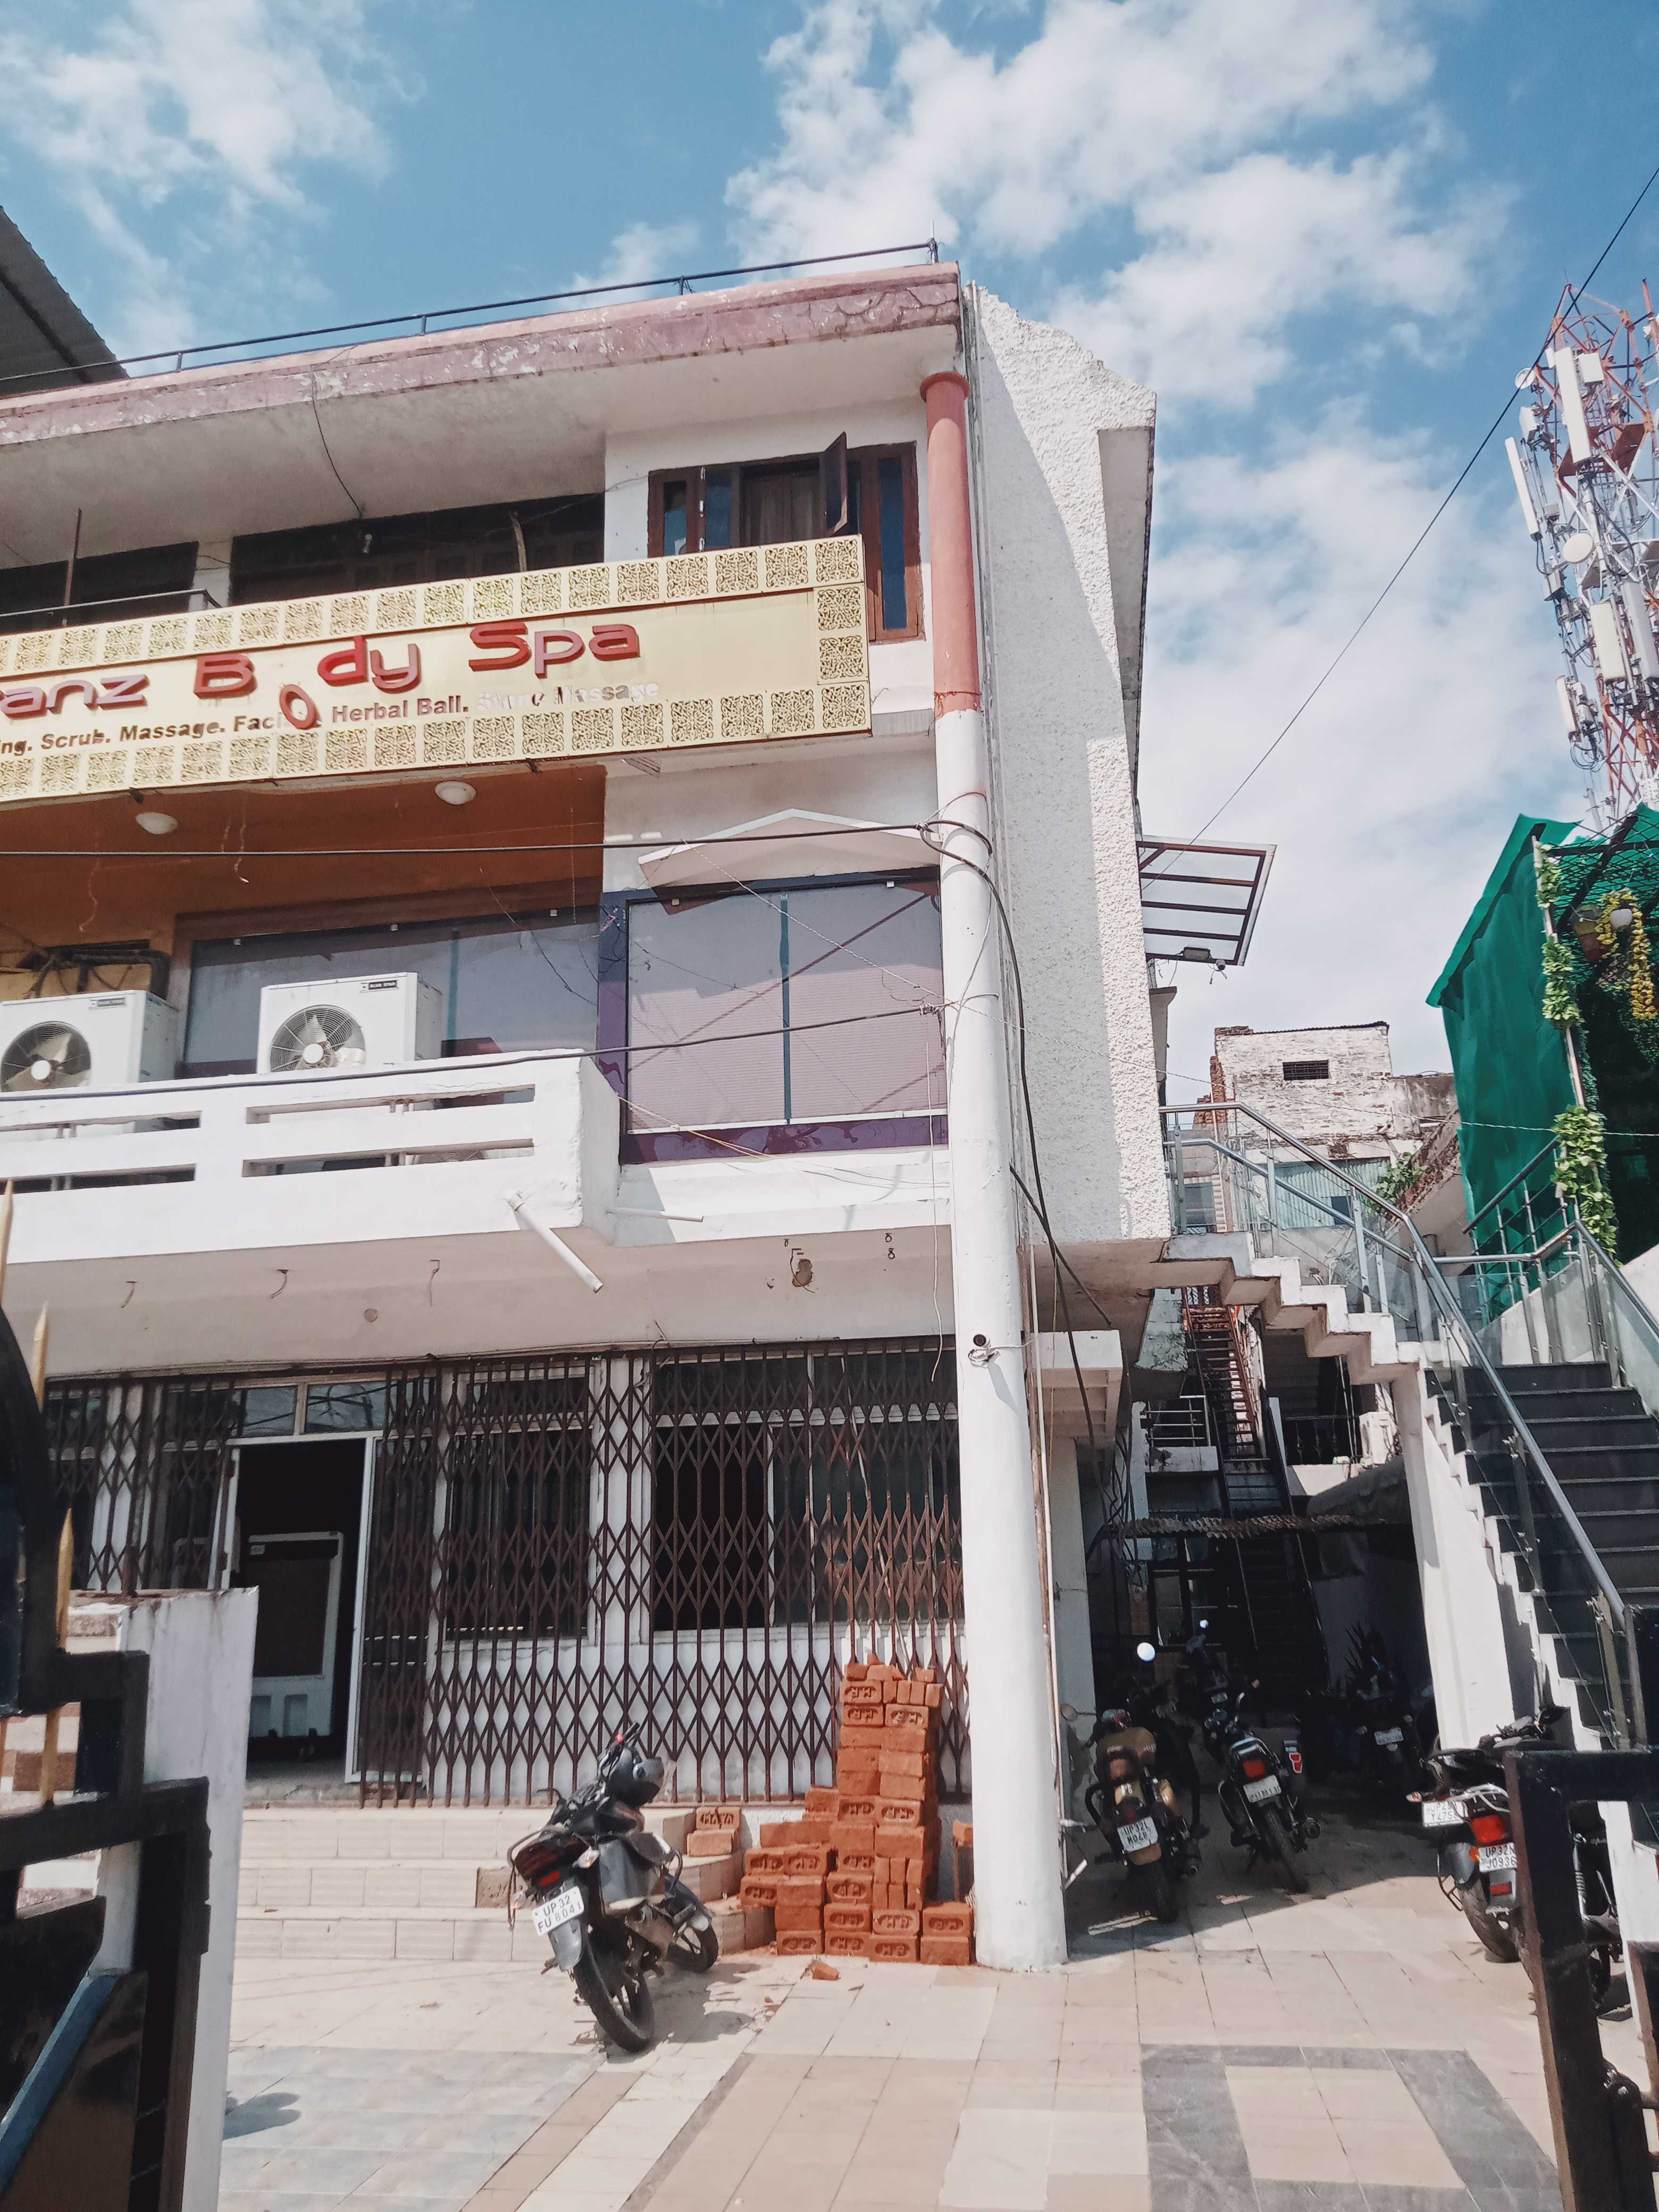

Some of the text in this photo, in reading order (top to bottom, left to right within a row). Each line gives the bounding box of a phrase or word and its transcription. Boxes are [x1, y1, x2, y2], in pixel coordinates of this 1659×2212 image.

[0, 674, 149, 720] anz
[468, 622, 641, 678] Spa
[0, 740, 32, 757] ng.
[40, 729, 111, 750] Scrub.
[120, 722, 225, 742] Massage.
[332, 700, 408, 723] Herbal
[417, 696, 469, 716] Ball.
